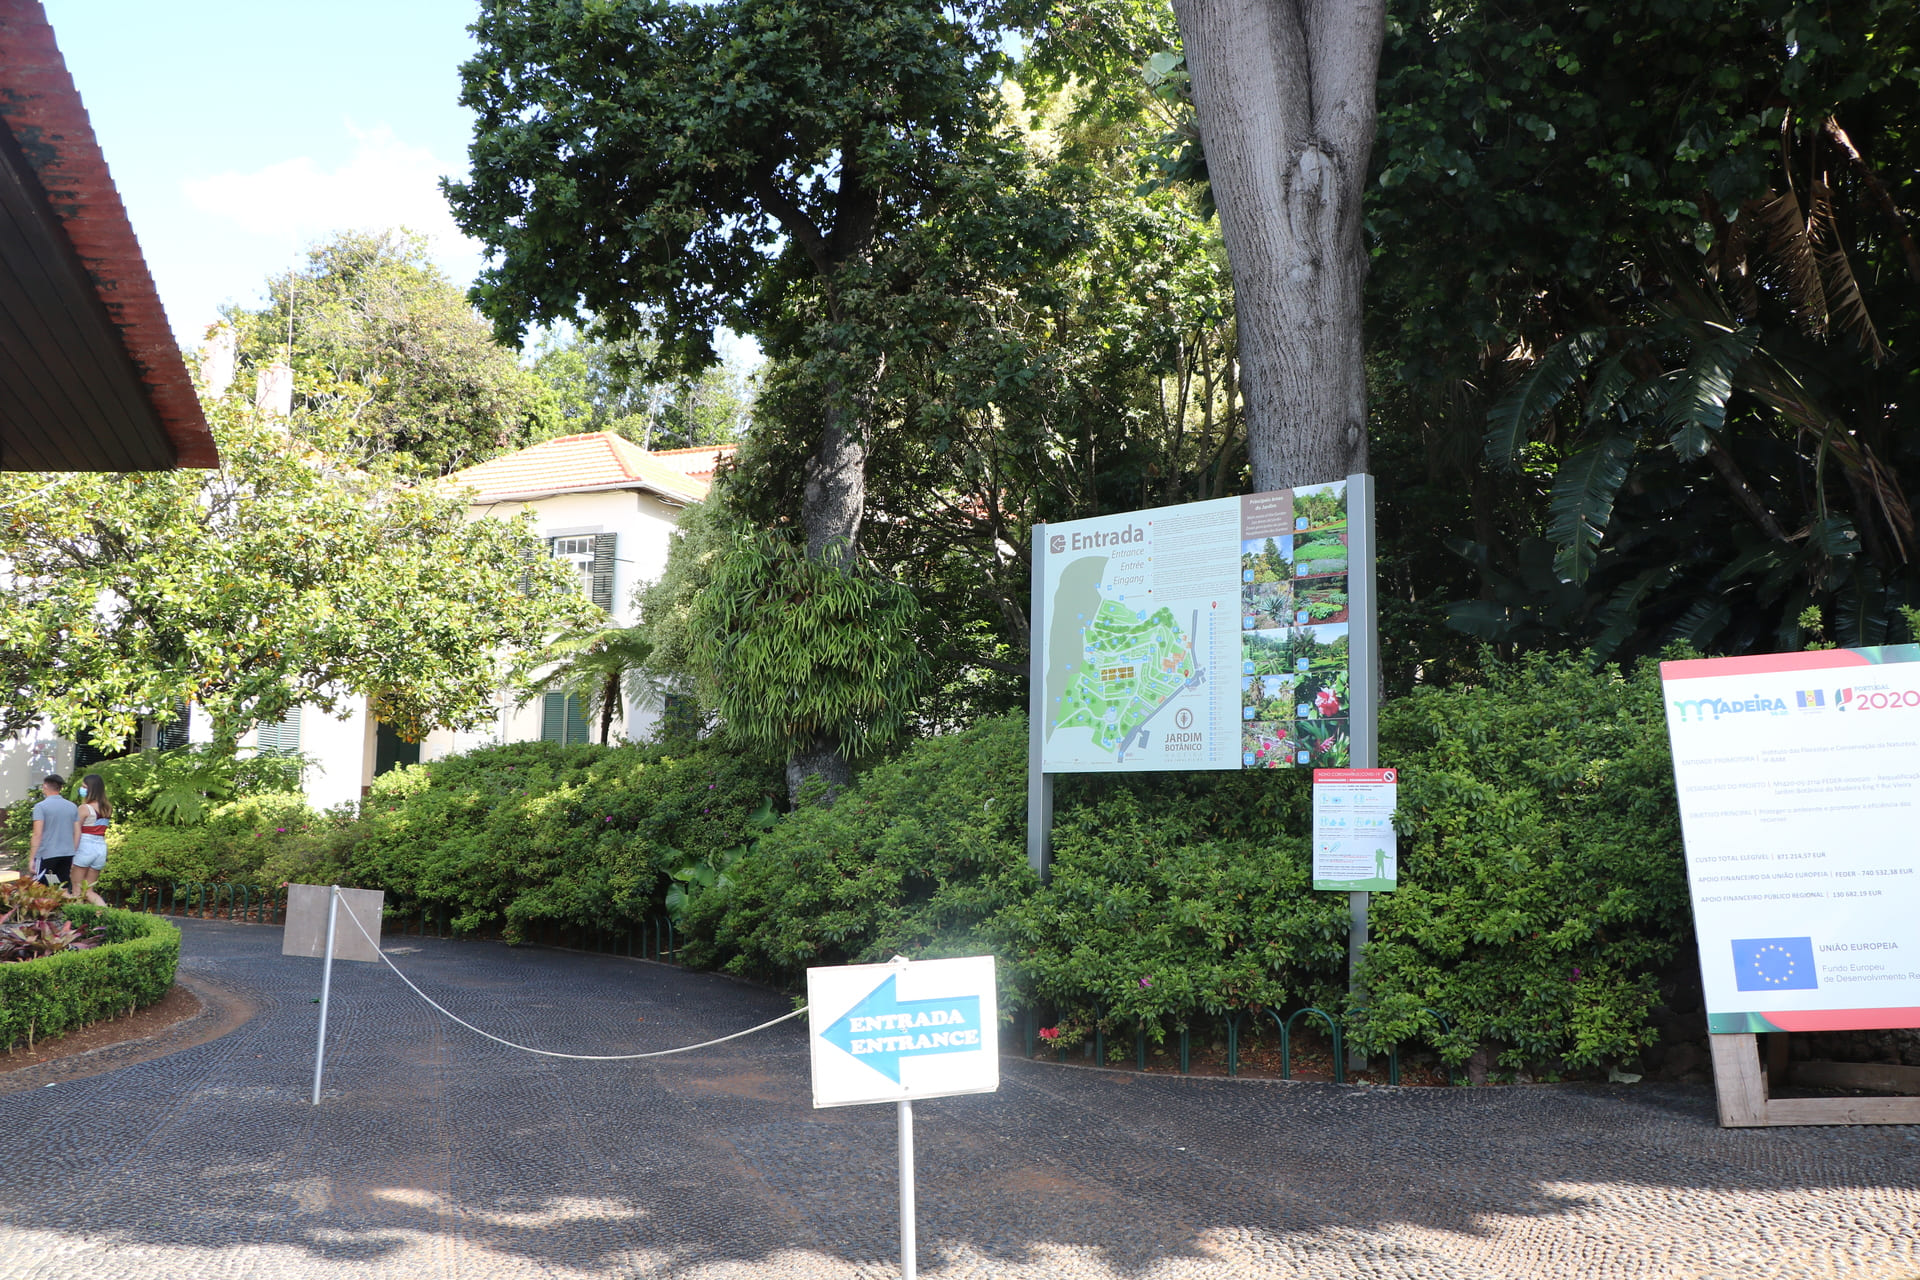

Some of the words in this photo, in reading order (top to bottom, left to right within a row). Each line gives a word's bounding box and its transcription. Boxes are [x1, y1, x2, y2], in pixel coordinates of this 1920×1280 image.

[1071, 523, 1144, 551] Entrada
[1112, 548, 1145, 559] Entrance
[1120, 560, 1145, 571] Entrée
[1113, 575, 1145, 585] Eingang
[1854, 684, 1890, 692] PORTUGAL
[1856, 689, 1920, 711] 2020
[1164, 732, 1202, 743] JARDIM
[1164, 743, 1202, 752] BOTÂNICO
[1697, 875, 1719, 883] APOIO
[1720, 873, 1760, 882] FINANCEIRO
[1771, 871, 1793, 880] UNIÃO
[1795, 870, 1829, 879] EUROPEIA
[1835, 870, 1857, 878] FEDER
[1899, 867, 1914, 875] EUR
[1700, 895, 1722, 903] APOIO
[1723, 893, 1763, 902] FINANCEIRO
[1791, 890, 1825, 899] REGIONAL
[1832, 890, 1845, 898] 130
[1868, 888, 1883, 897] EUR
[1818, 942, 1848, 953] UNIÃO
[1850, 941, 1899, 951] EUROPEIA
[1822, 964, 1848, 972] Fundo
[1849, 963, 1886, 973] Europeu
[1823, 975, 1834, 983] de
[1836, 974, 1907, 983] Desenvolvimento
[849, 1008, 966, 1034] ENTRADA
[850, 1029, 979, 1055] ENTRANCE
